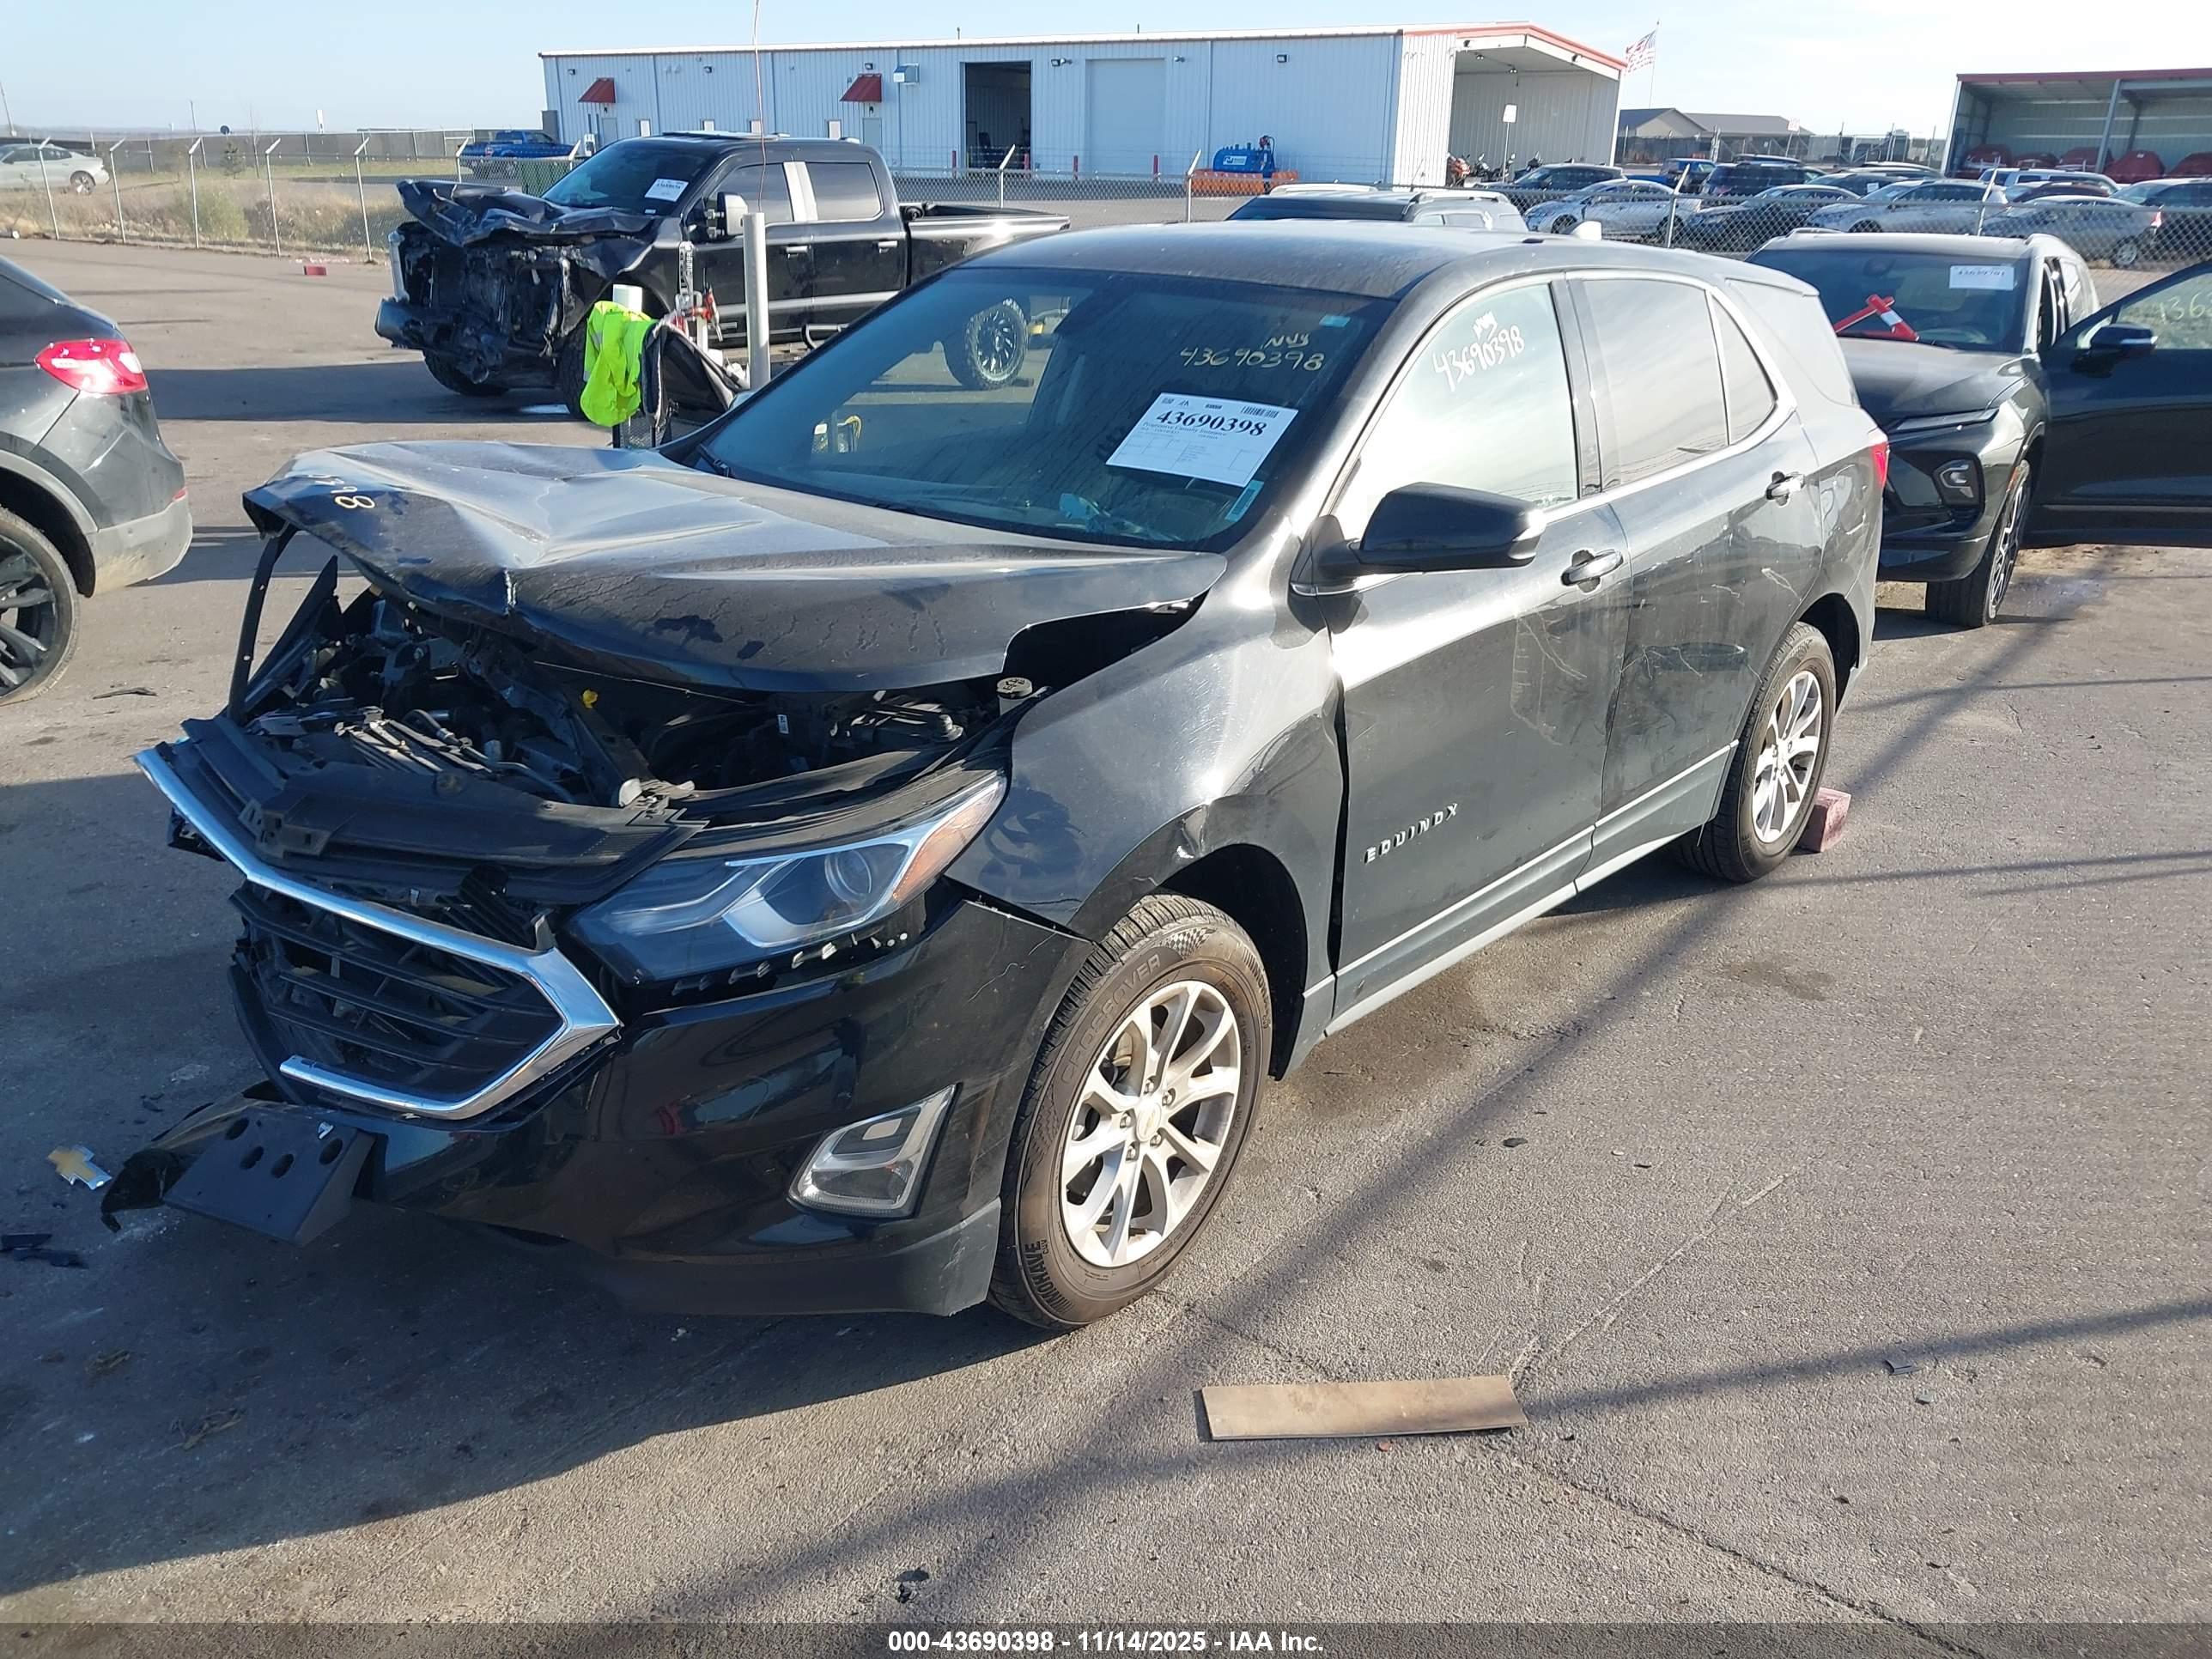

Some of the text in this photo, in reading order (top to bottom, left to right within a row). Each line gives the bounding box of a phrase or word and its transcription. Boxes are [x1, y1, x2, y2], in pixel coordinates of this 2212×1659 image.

[1180, 346, 1325, 371] 43690398
[1432, 325, 1525, 392] 43690398
[1156, 410, 1267, 437] 43690398
[1364, 802, 1458, 866] EQUINOX
[1060, 953, 1162, 1084] CROSSOVER
